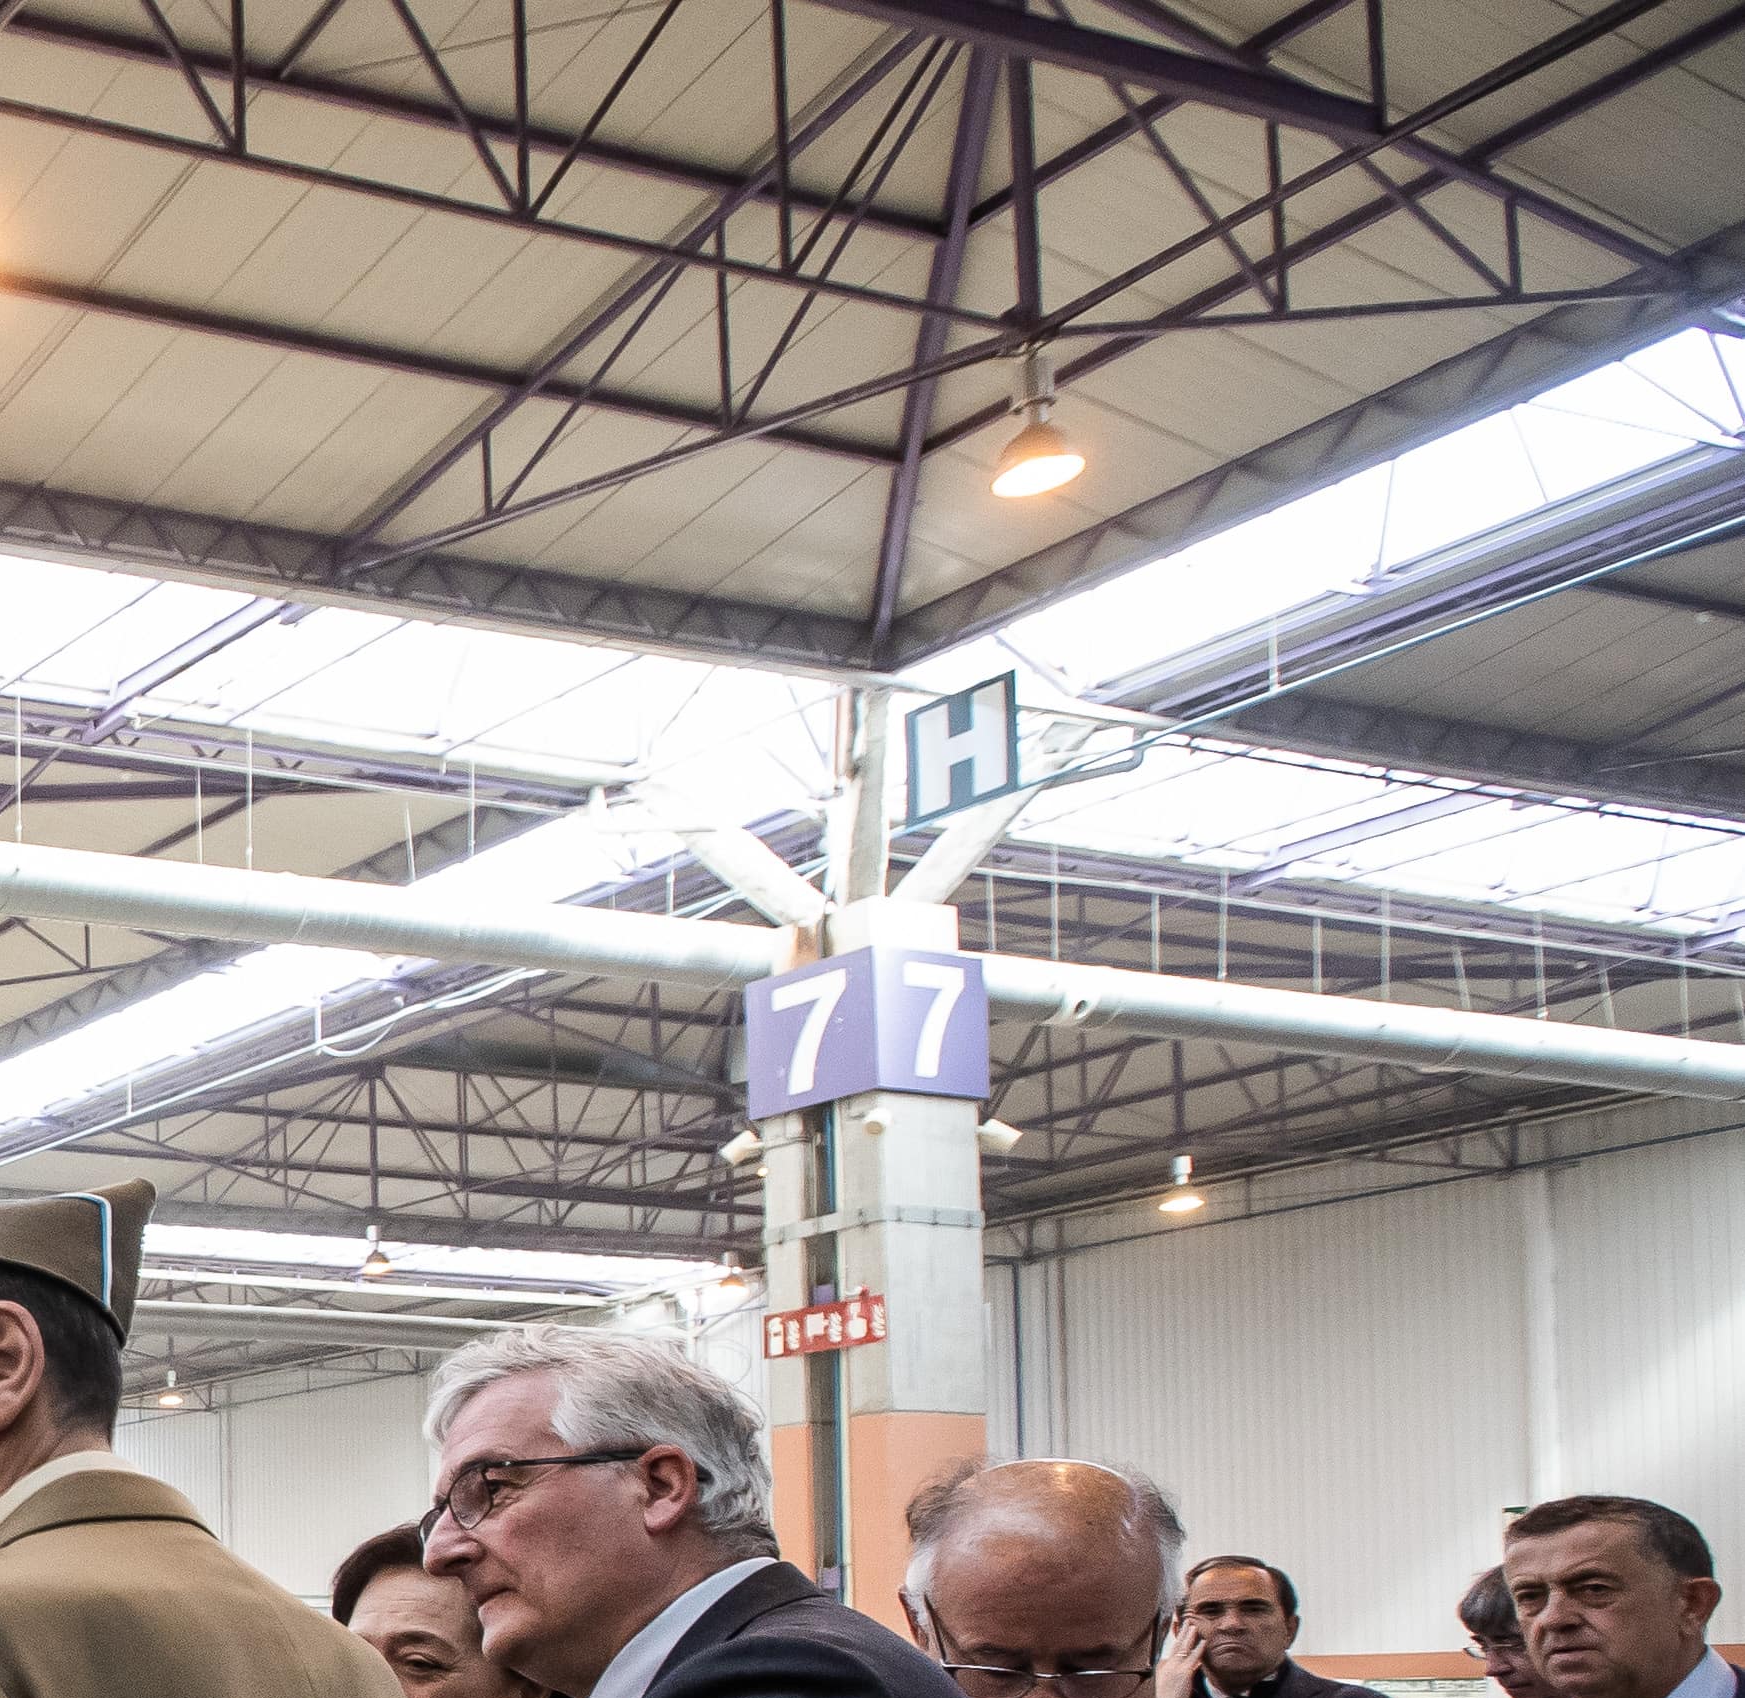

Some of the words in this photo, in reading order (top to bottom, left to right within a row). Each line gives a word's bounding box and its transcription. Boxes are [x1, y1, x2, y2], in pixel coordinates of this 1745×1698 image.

[917, 680, 1008, 818] H
[771, 967, 846, 1096] 7
[903, 961, 965, 1078] 7
